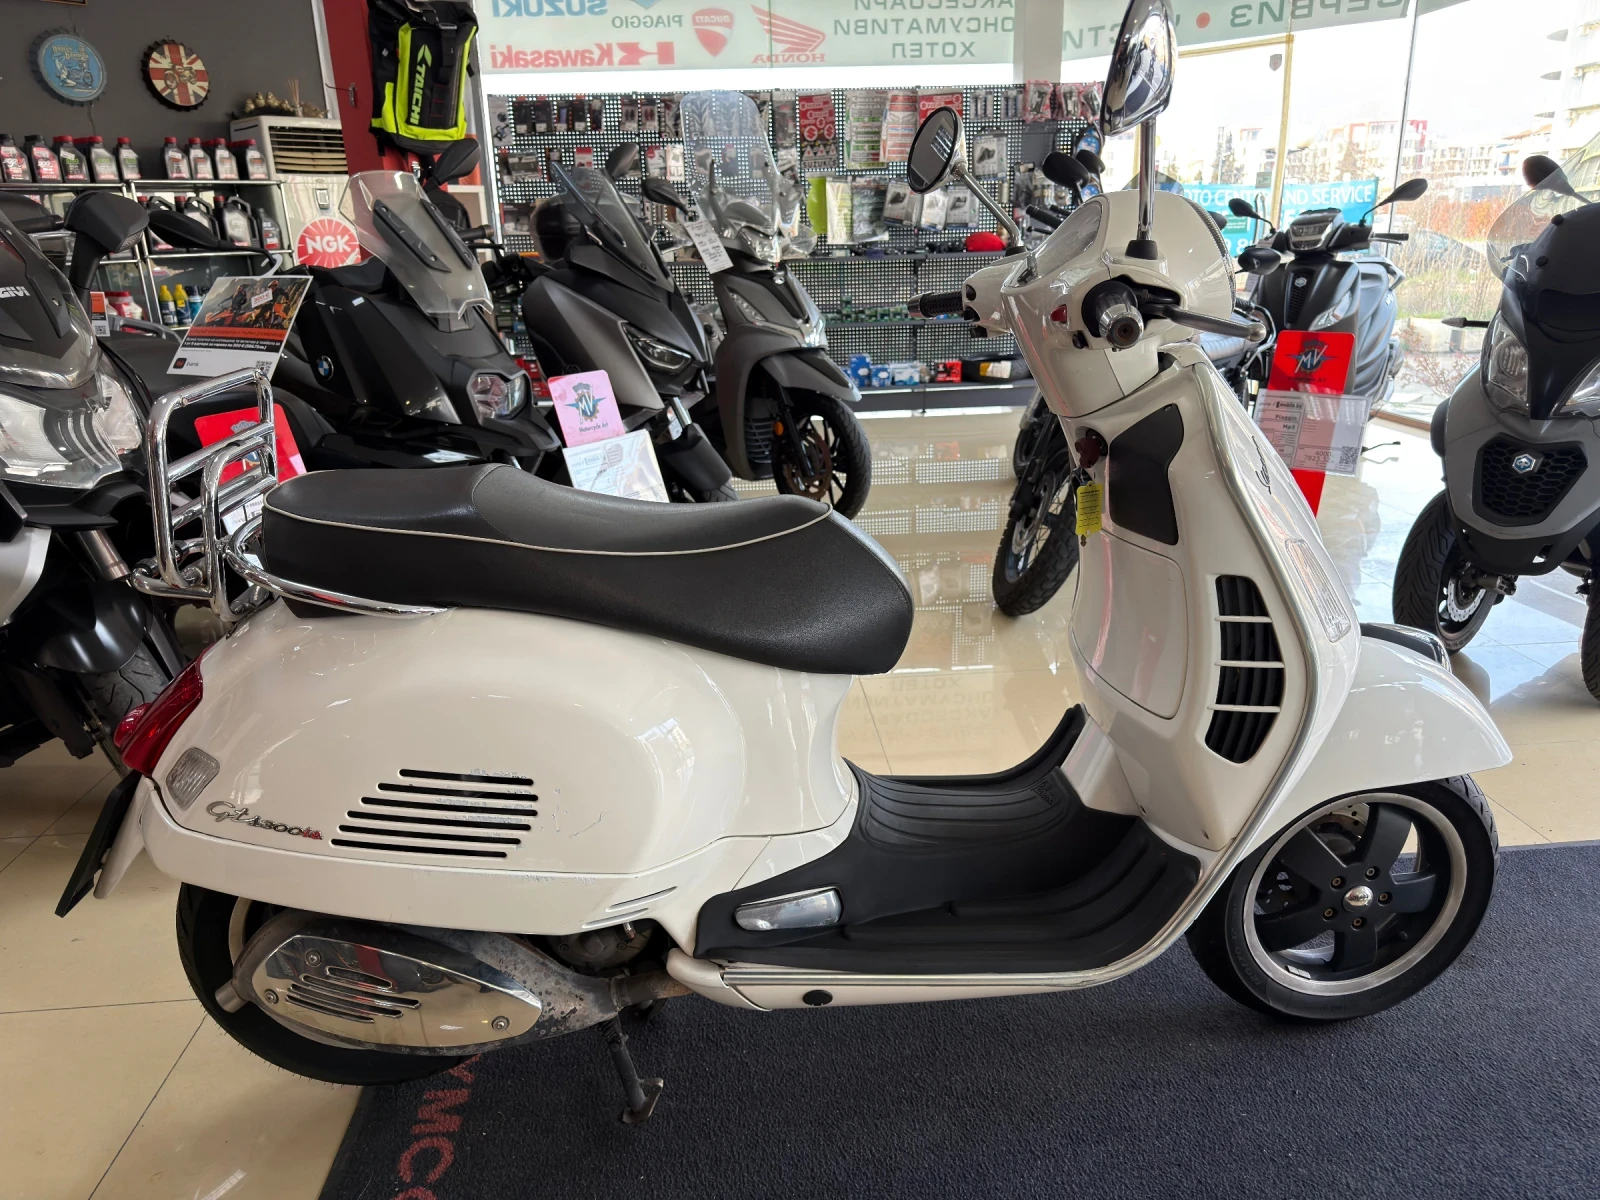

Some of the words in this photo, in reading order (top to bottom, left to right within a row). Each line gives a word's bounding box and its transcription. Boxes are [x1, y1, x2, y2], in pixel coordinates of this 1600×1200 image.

[410, 63, 426, 125] TAICHI
[1312, 185, 1373, 205] SERVICE
[305, 234, 351, 255] NGK
[0, 286, 30, 298] GIVI
[1294, 344, 1328, 374] MV
[579, 385, 593, 424] MV
